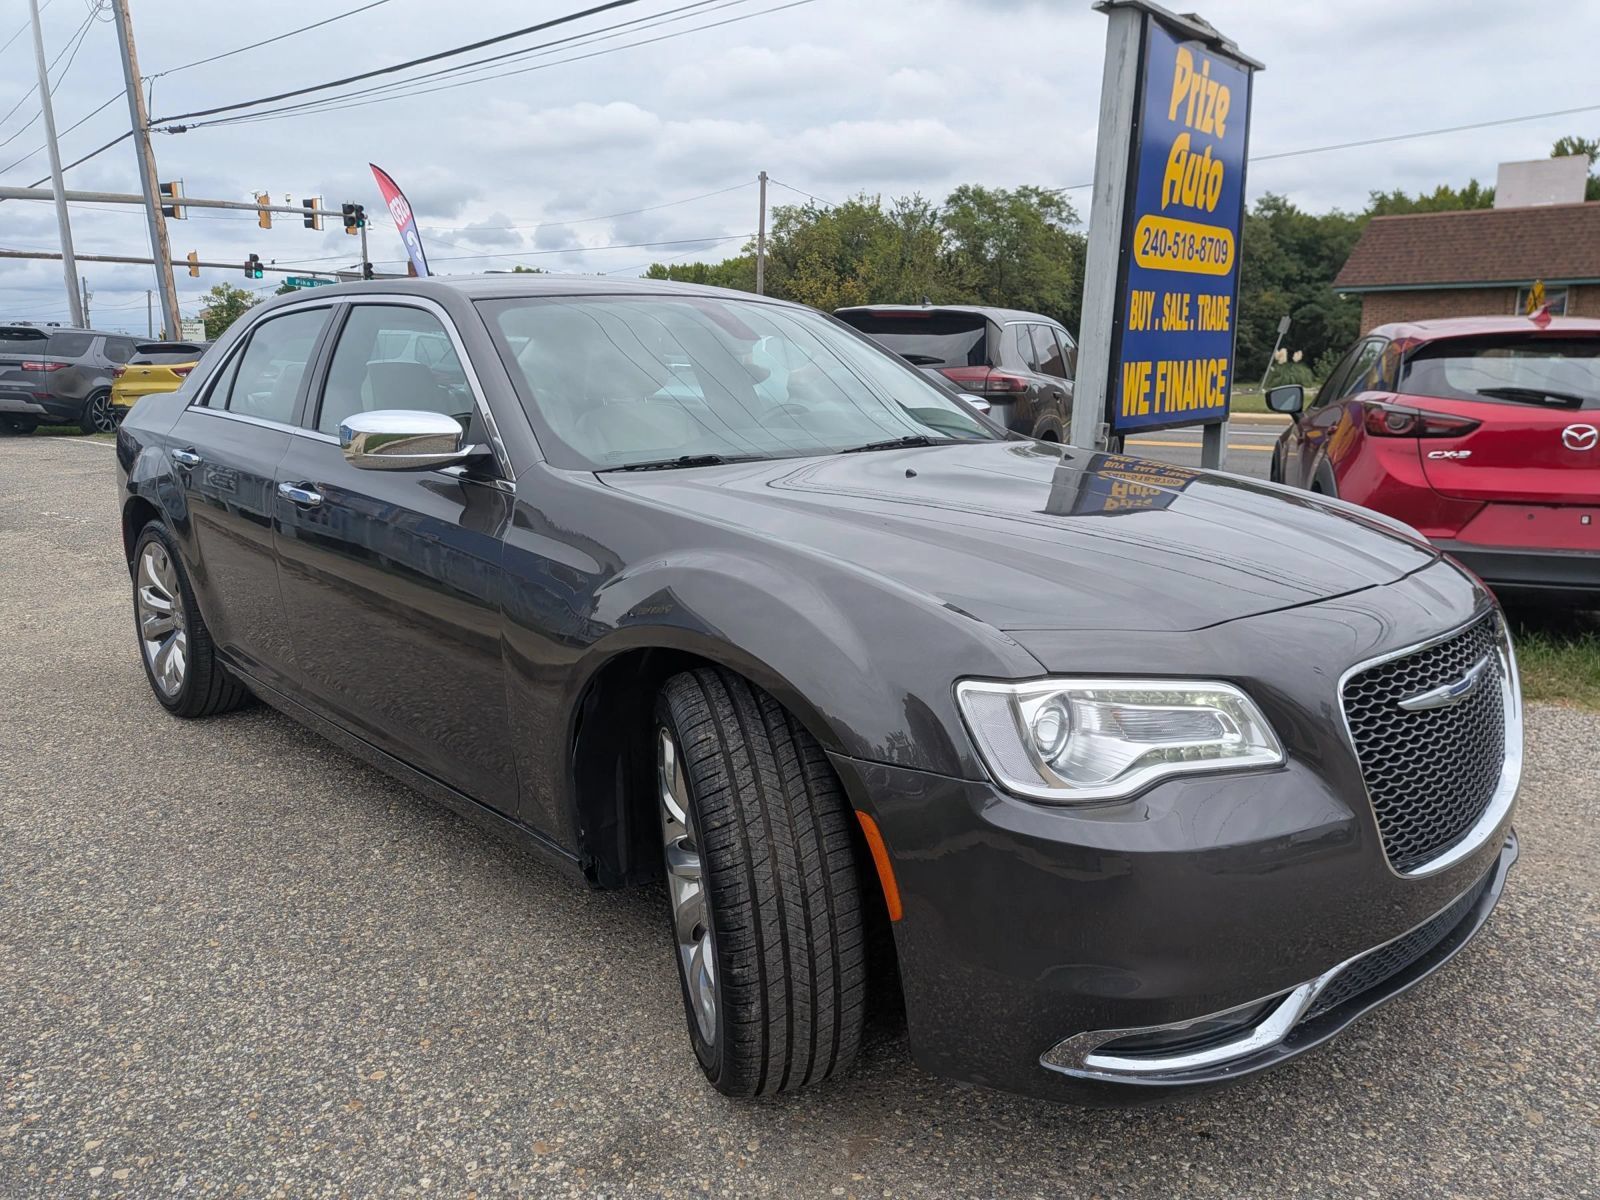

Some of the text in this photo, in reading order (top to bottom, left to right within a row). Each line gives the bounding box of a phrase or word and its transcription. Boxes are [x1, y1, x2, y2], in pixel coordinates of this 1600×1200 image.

[1168, 46, 1231, 139] Prize
[1161, 132, 1224, 213] Auto
[1141, 227, 1228, 264] 240-518-8709
[1197, 294, 1230, 331] TRADE
[1122, 358, 1228, 417] WE FINANCE
